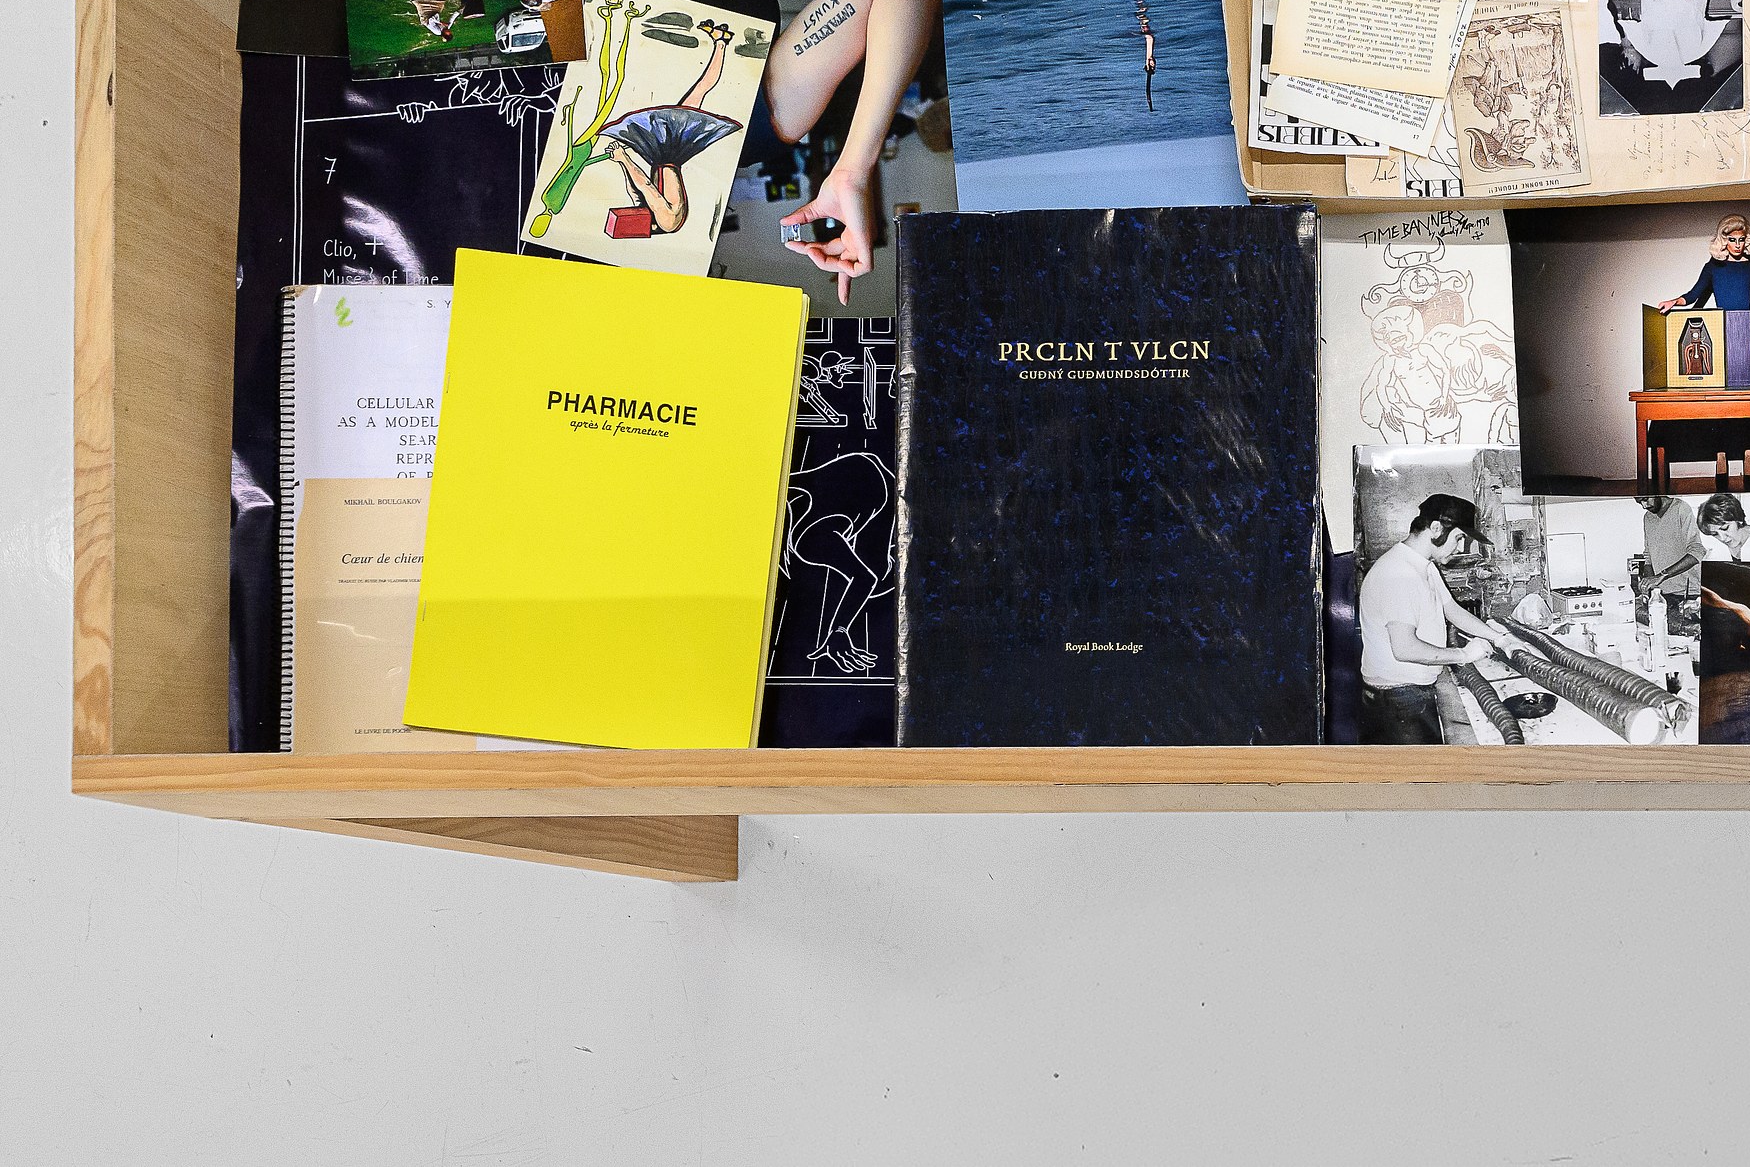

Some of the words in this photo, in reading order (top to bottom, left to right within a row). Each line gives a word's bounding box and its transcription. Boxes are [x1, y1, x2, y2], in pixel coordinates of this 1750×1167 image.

[324, 156, 337, 185] 7
[1358, 225, 1400, 245] TIME
[323, 238, 357, 260] Clio,
[323, 269, 361, 285] Muse
[383, 269, 397, 285] of
[998, 341, 1095, 361] PRCLN
[1104, 340, 1123, 361] T
[1131, 340, 1211, 361] VLCN
[356, 397, 435, 409] CELLULAR
[547, 390, 698, 426] PHARMACIE
[337, 416, 357, 428] AS
[366, 416, 377, 428] A
[385, 416, 439, 428] MODEL
[570, 419, 599, 432] après
[601, 419, 612, 431] la
[613, 421, 670, 438] fermeture
[399, 434, 437, 446] SEAR
[396, 453, 434, 465] REPR
[341, 553, 374, 564] Cœur
[376, 552, 391, 564] de
[394, 553, 425, 564] chien
[1064, 641, 1090, 654] Royal
[1091, 641, 1114, 652] Book
[1115, 641, 1144, 654] Lodge
